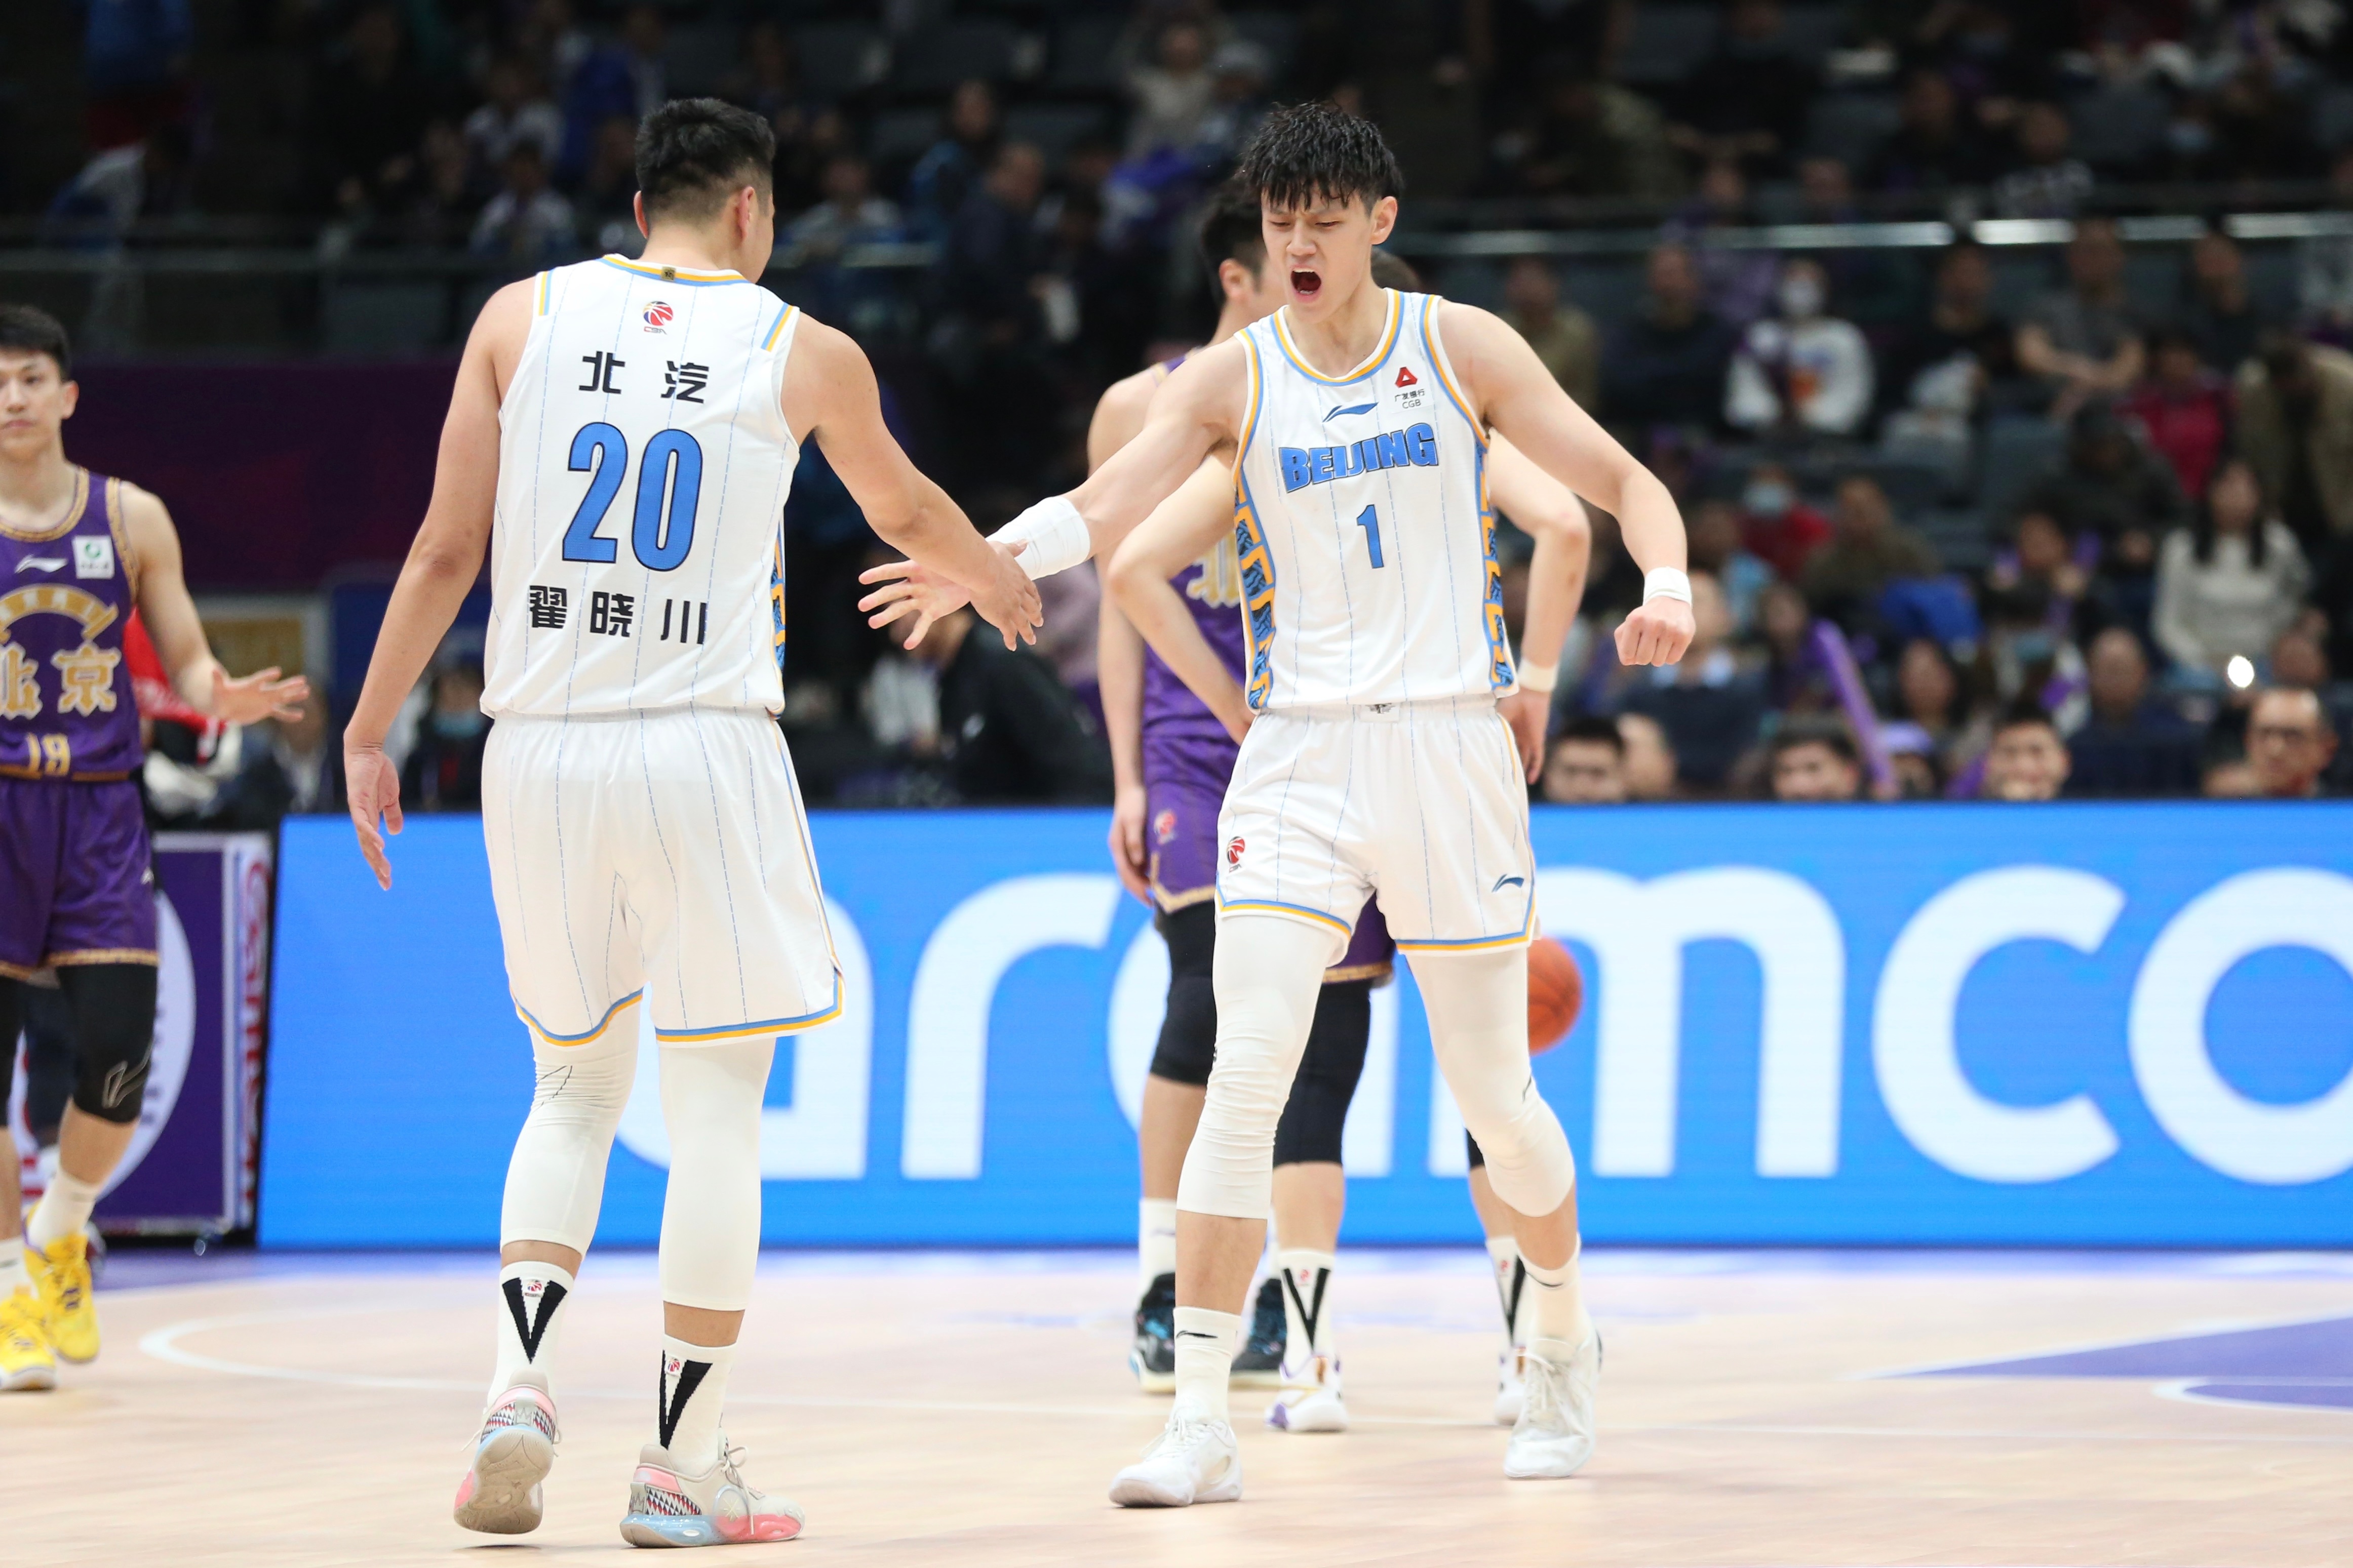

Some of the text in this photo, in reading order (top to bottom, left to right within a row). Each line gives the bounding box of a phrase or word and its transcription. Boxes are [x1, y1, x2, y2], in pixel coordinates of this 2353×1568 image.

[578, 351, 710, 404] 北汽
[1394, 388, 1426, 403] 广发银行
[1402, 398, 1422, 409] CGB
[1279, 422, 1439, 493] BEIJING
[562, 421, 703, 572] 20
[1357, 504, 1384, 569] 1
[529, 585, 708, 645] 翟晓川
[26, 732, 71, 776] 19
[616, 864, 2353, 1186] rmco
